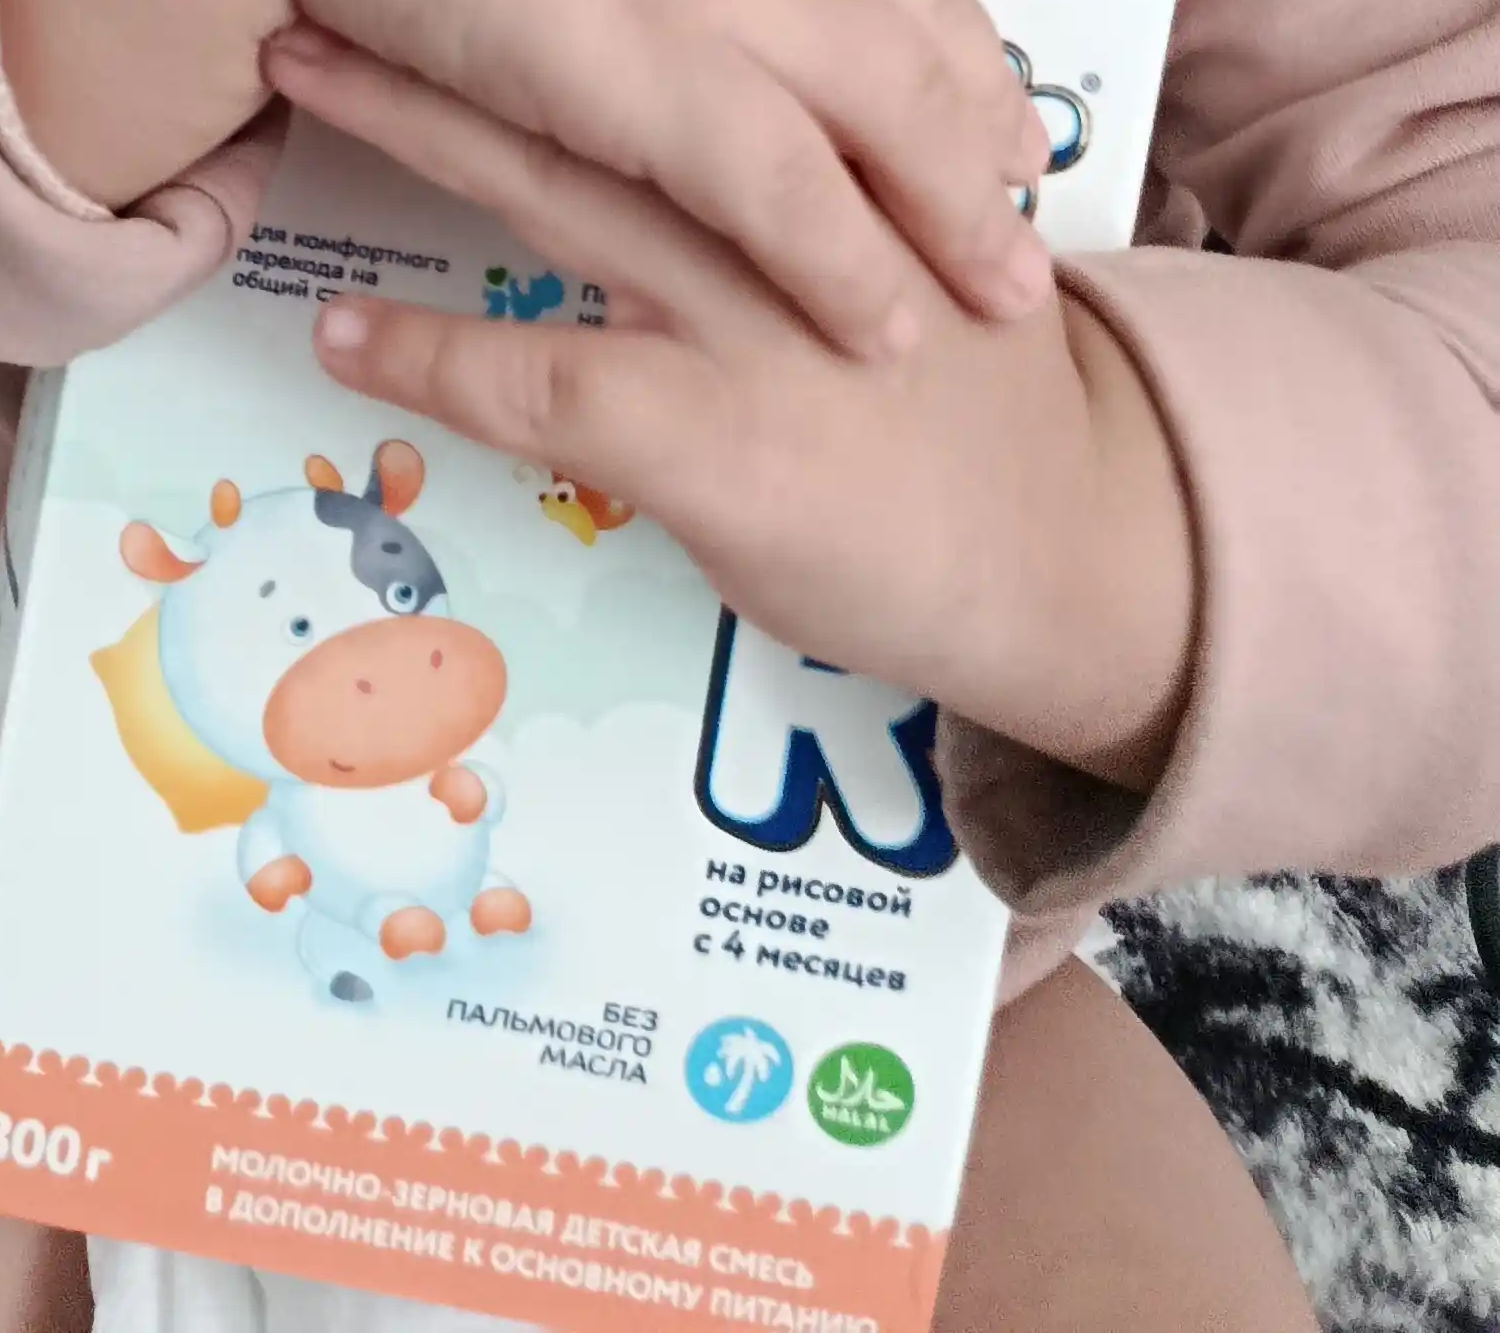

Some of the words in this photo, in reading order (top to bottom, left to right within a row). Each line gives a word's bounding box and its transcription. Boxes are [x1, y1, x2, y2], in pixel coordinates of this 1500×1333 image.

[236, 246, 344, 280] перехода
[350, 264, 378, 286] на
[293, 228, 450, 274] комфортного
[231, 270, 309, 298] общий
[706, 858, 746, 885] на
[756, 868, 913, 918] рисовой
[699, 895, 831, 939] основе
[693, 932, 712, 955] с
[721, 930, 746, 959] 4
[756, 944, 907, 992] месяцев
[446, 998, 653, 1057] ПАЛЬМОВОГО
[602, 1001, 658, 1032] БЕЗ
[539, 1044, 647, 1084] МАСЛА
[821, 1105, 890, 1134] HALAL
[210, 1143, 554, 1236] МОЛОЧНО-ЗЕРНОВАЯ
[559, 1213, 702, 1269] ДЕТСКАЯ
[708, 1242, 815, 1290] СМЕСЬ
[204, 1183, 222, 1214] В
[228, 1189, 455, 1263] ДОПОЛНЕНИЕ
[461, 1238, 485, 1268] К
[489, 1243, 702, 1310] ОСНОВНОМУ
[709, 1286, 880, 1333] ПИТАНИЮ
